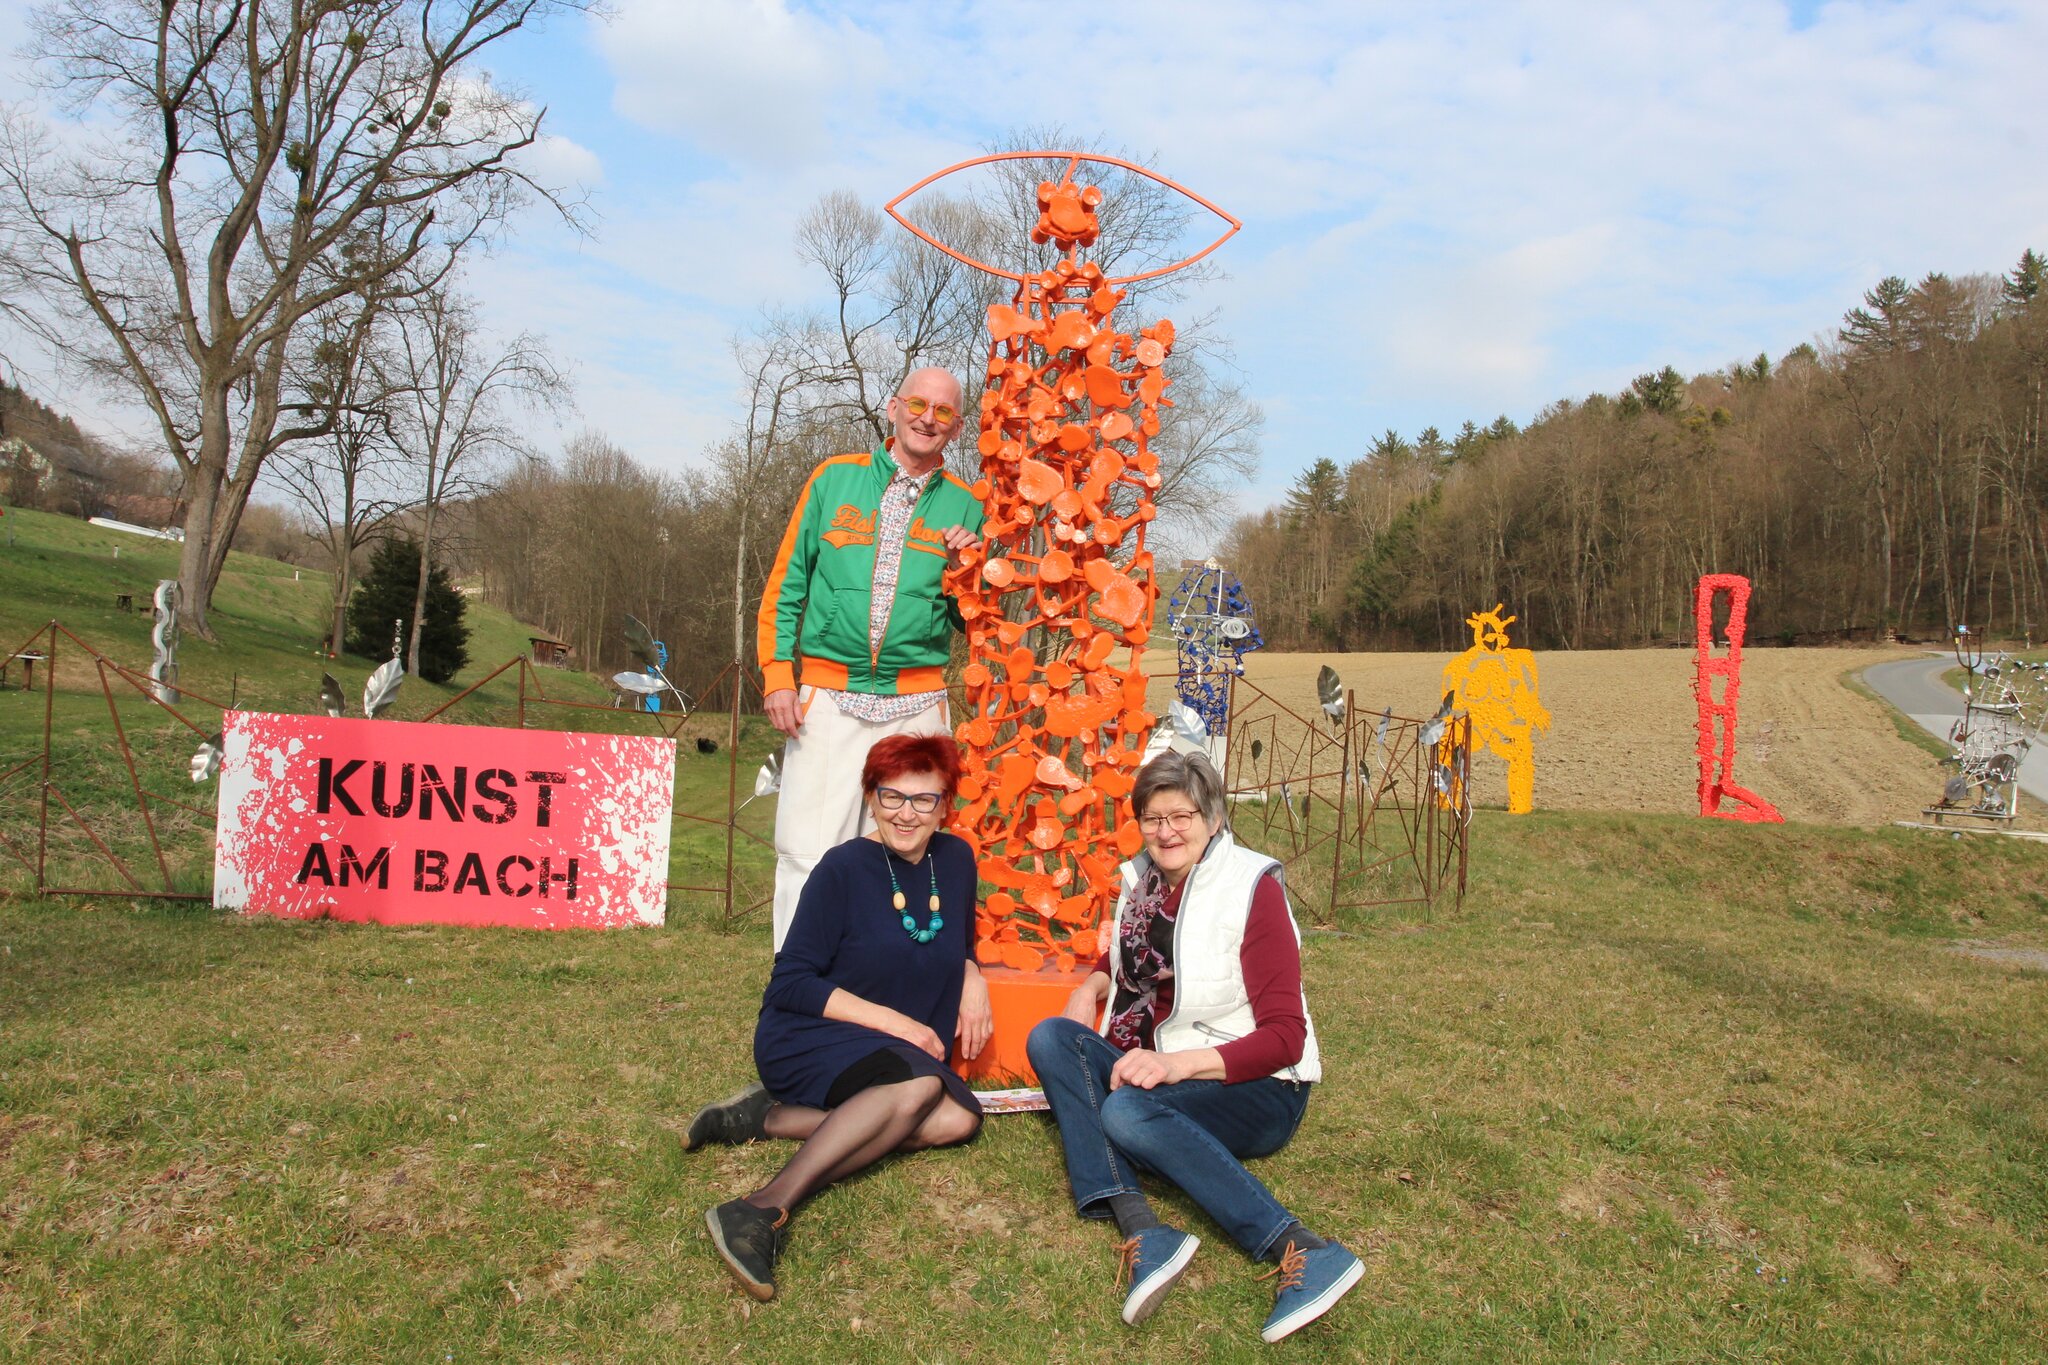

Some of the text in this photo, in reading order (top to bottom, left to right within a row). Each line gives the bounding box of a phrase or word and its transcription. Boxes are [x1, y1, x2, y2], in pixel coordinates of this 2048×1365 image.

[316, 757, 567, 828] KUNST
[297, 842, 579, 900] AM BACH
